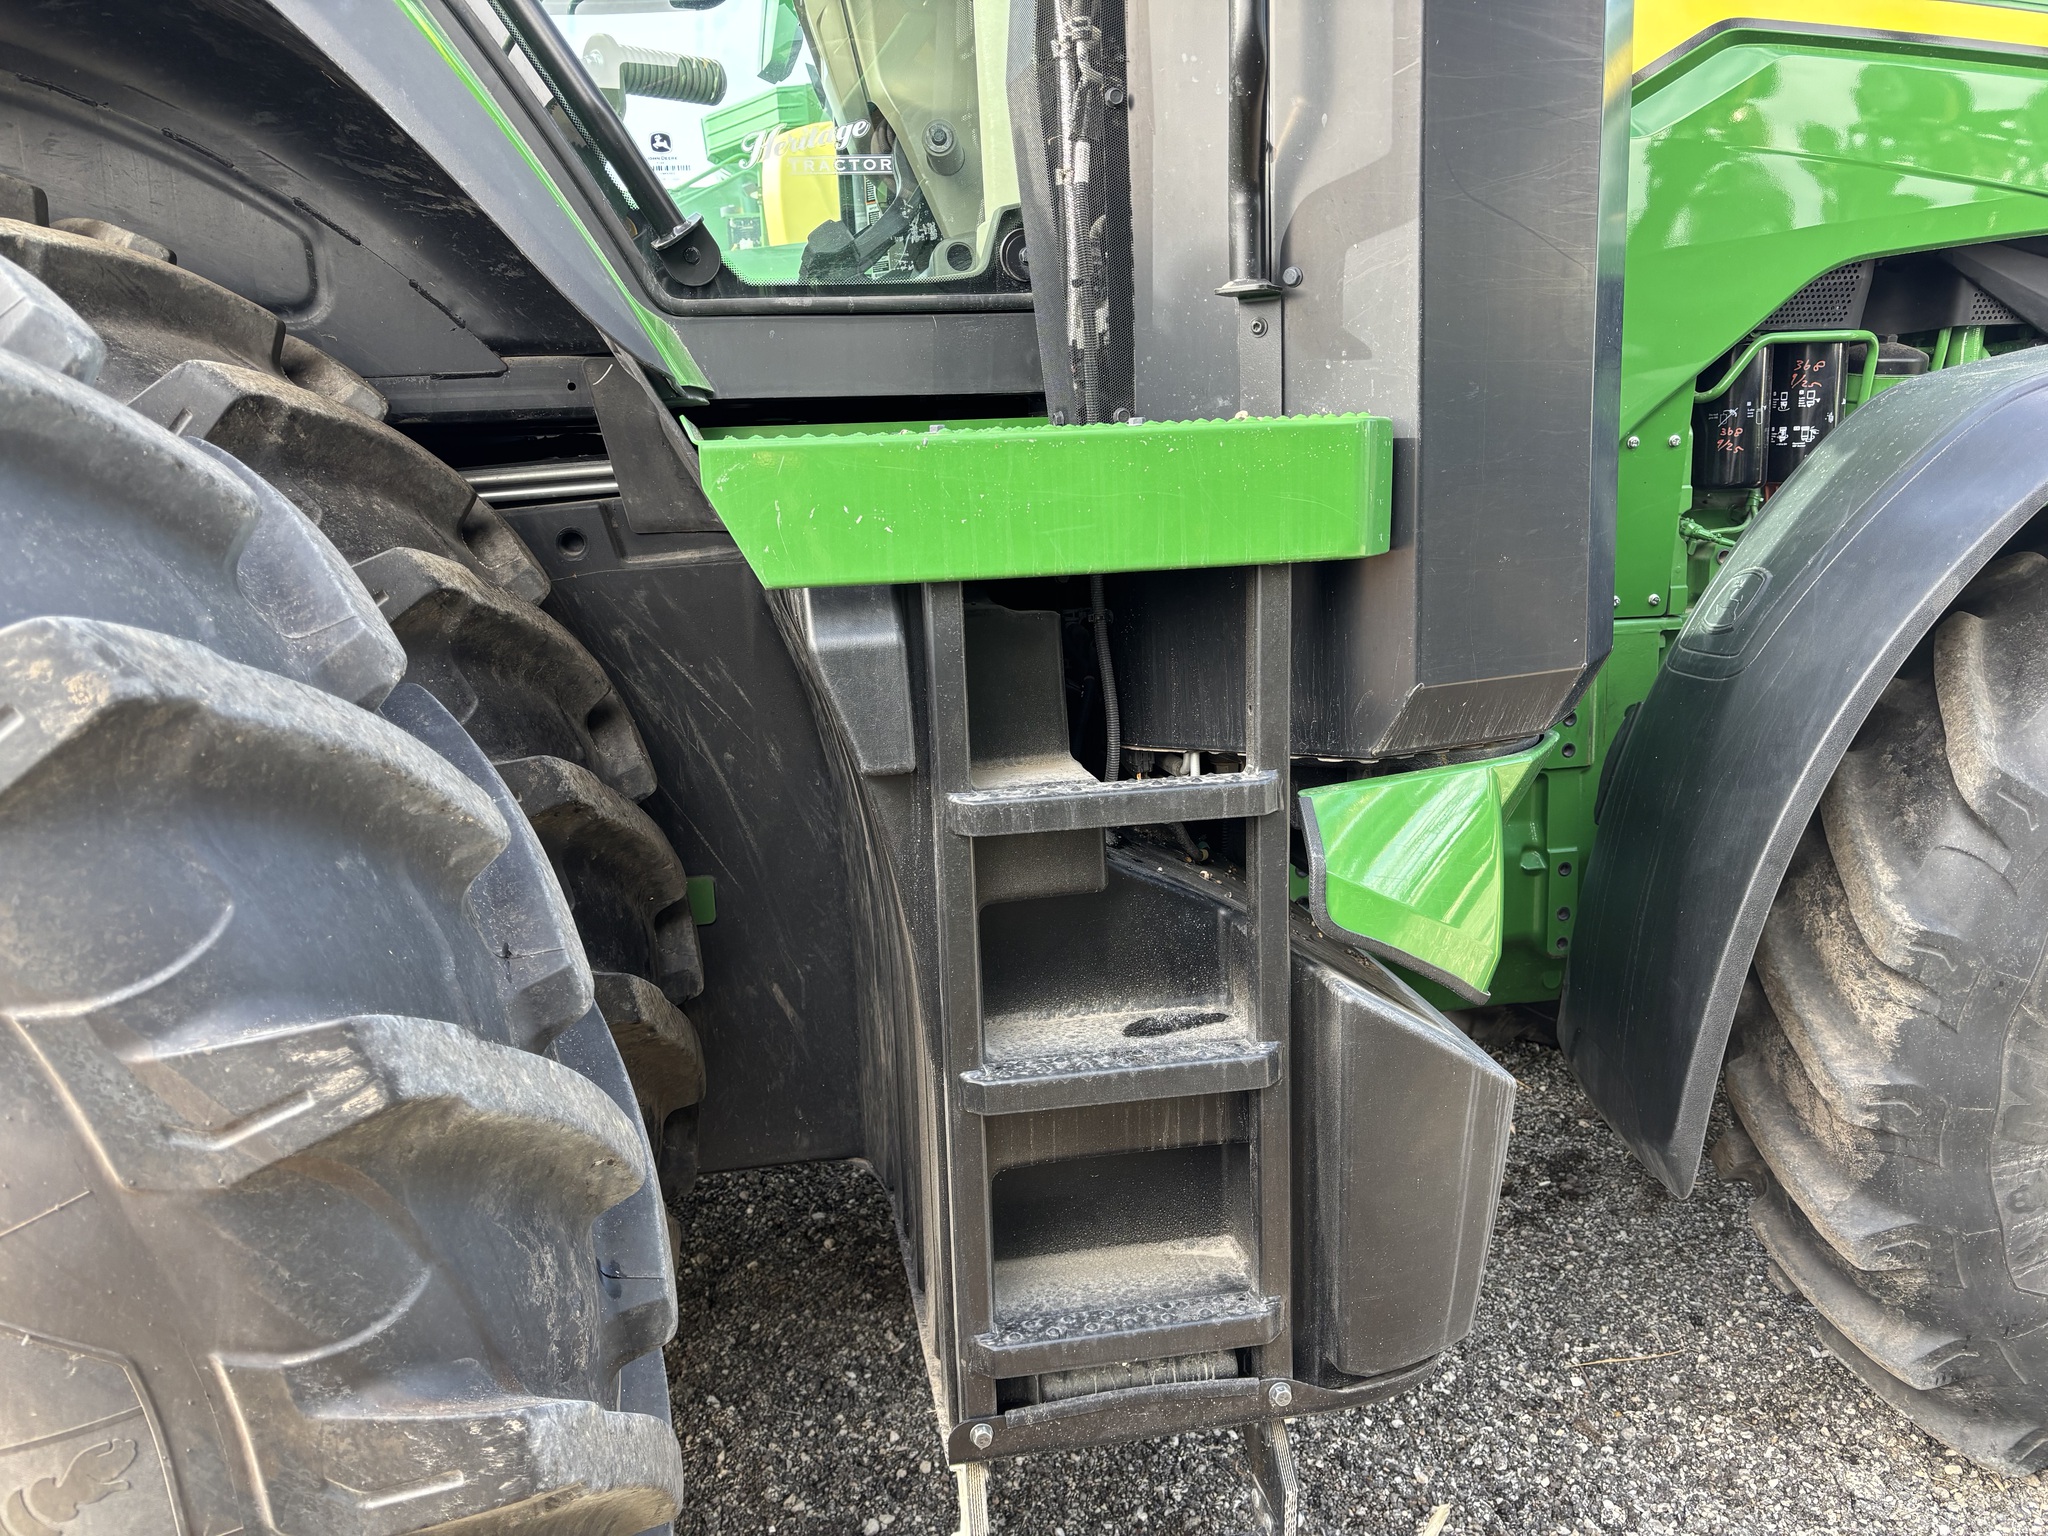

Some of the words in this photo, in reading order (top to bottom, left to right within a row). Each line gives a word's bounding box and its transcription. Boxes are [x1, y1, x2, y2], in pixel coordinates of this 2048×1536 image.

[738, 119, 872, 170] Heritage
[790, 158, 892, 171] TRACTOR
[1794, 359, 1826, 372] 368
[1719, 427, 1744, 437] 368
